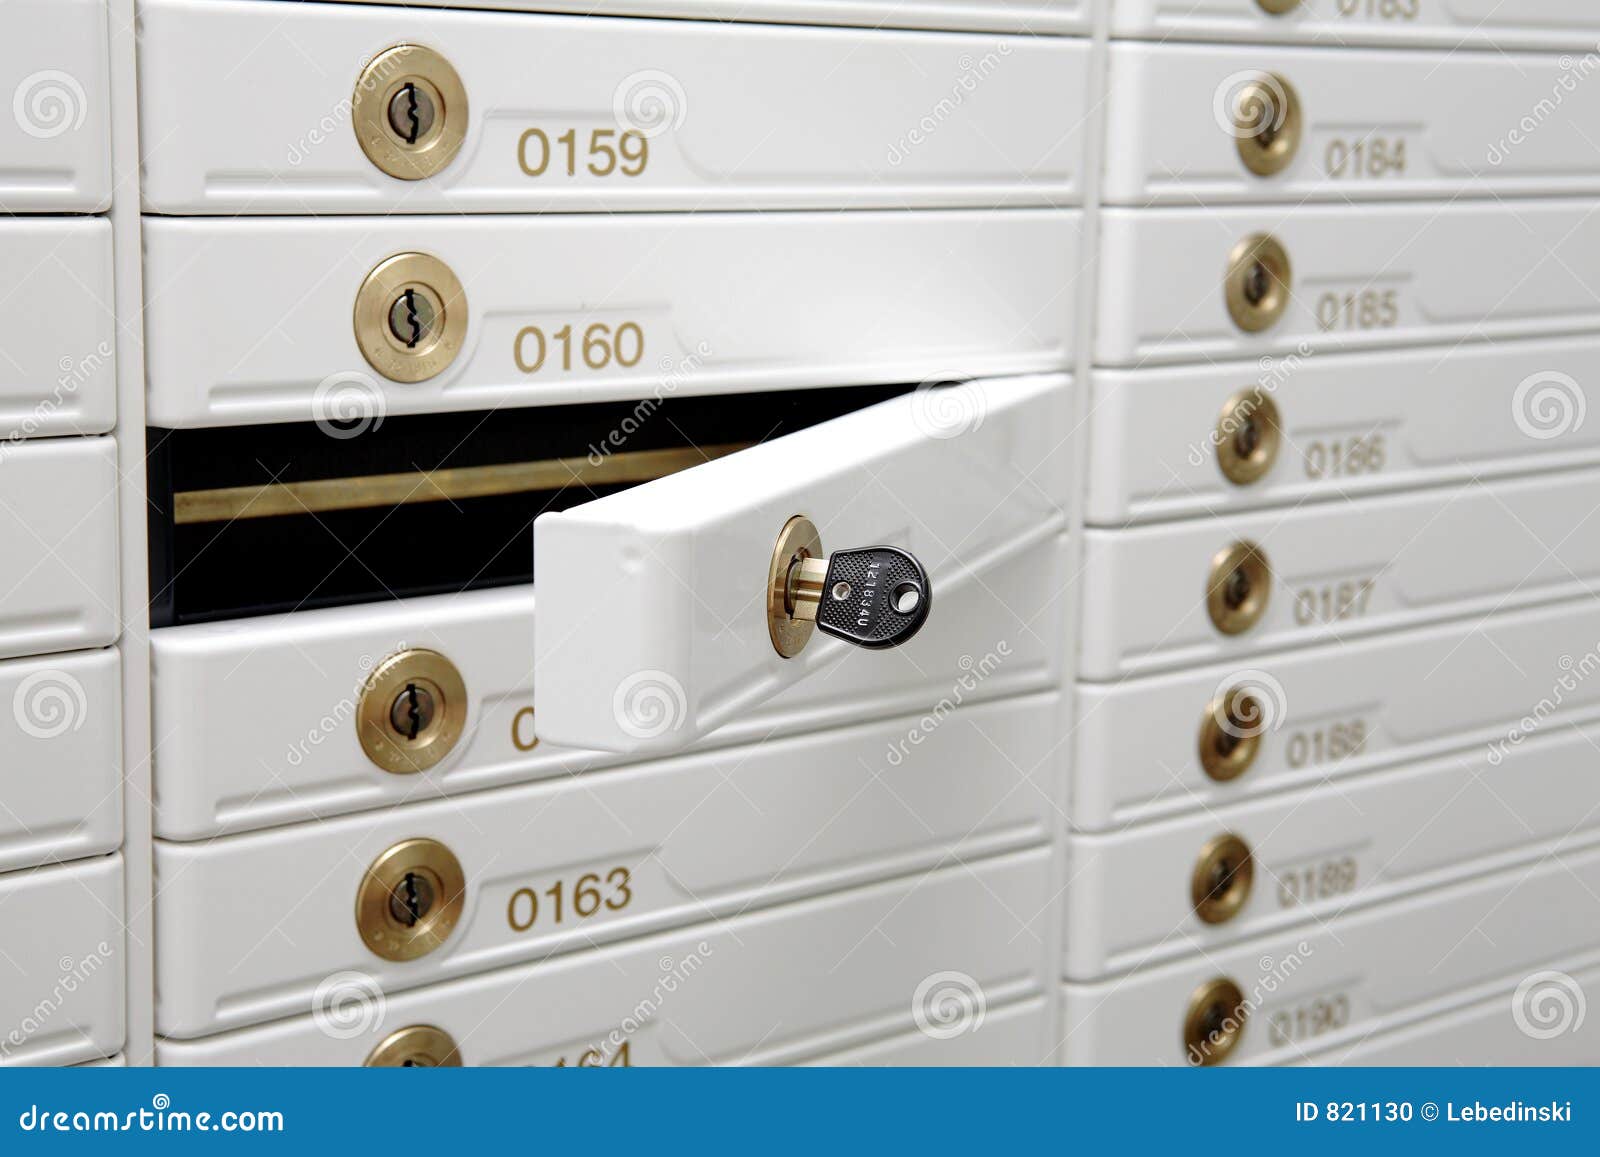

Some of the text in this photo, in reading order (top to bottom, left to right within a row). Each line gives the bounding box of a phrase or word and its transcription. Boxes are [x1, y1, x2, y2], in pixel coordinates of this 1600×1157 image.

[517, 127, 650, 178] 0159
[1324, 139, 1406, 179] 0184
[1316, 290, 1399, 332] 0185
[512, 321, 645, 374] 0160
[1304, 435, 1386, 480] 0186
[1293, 578, 1376, 626] 0187
[507, 866, 634, 933] 0163
